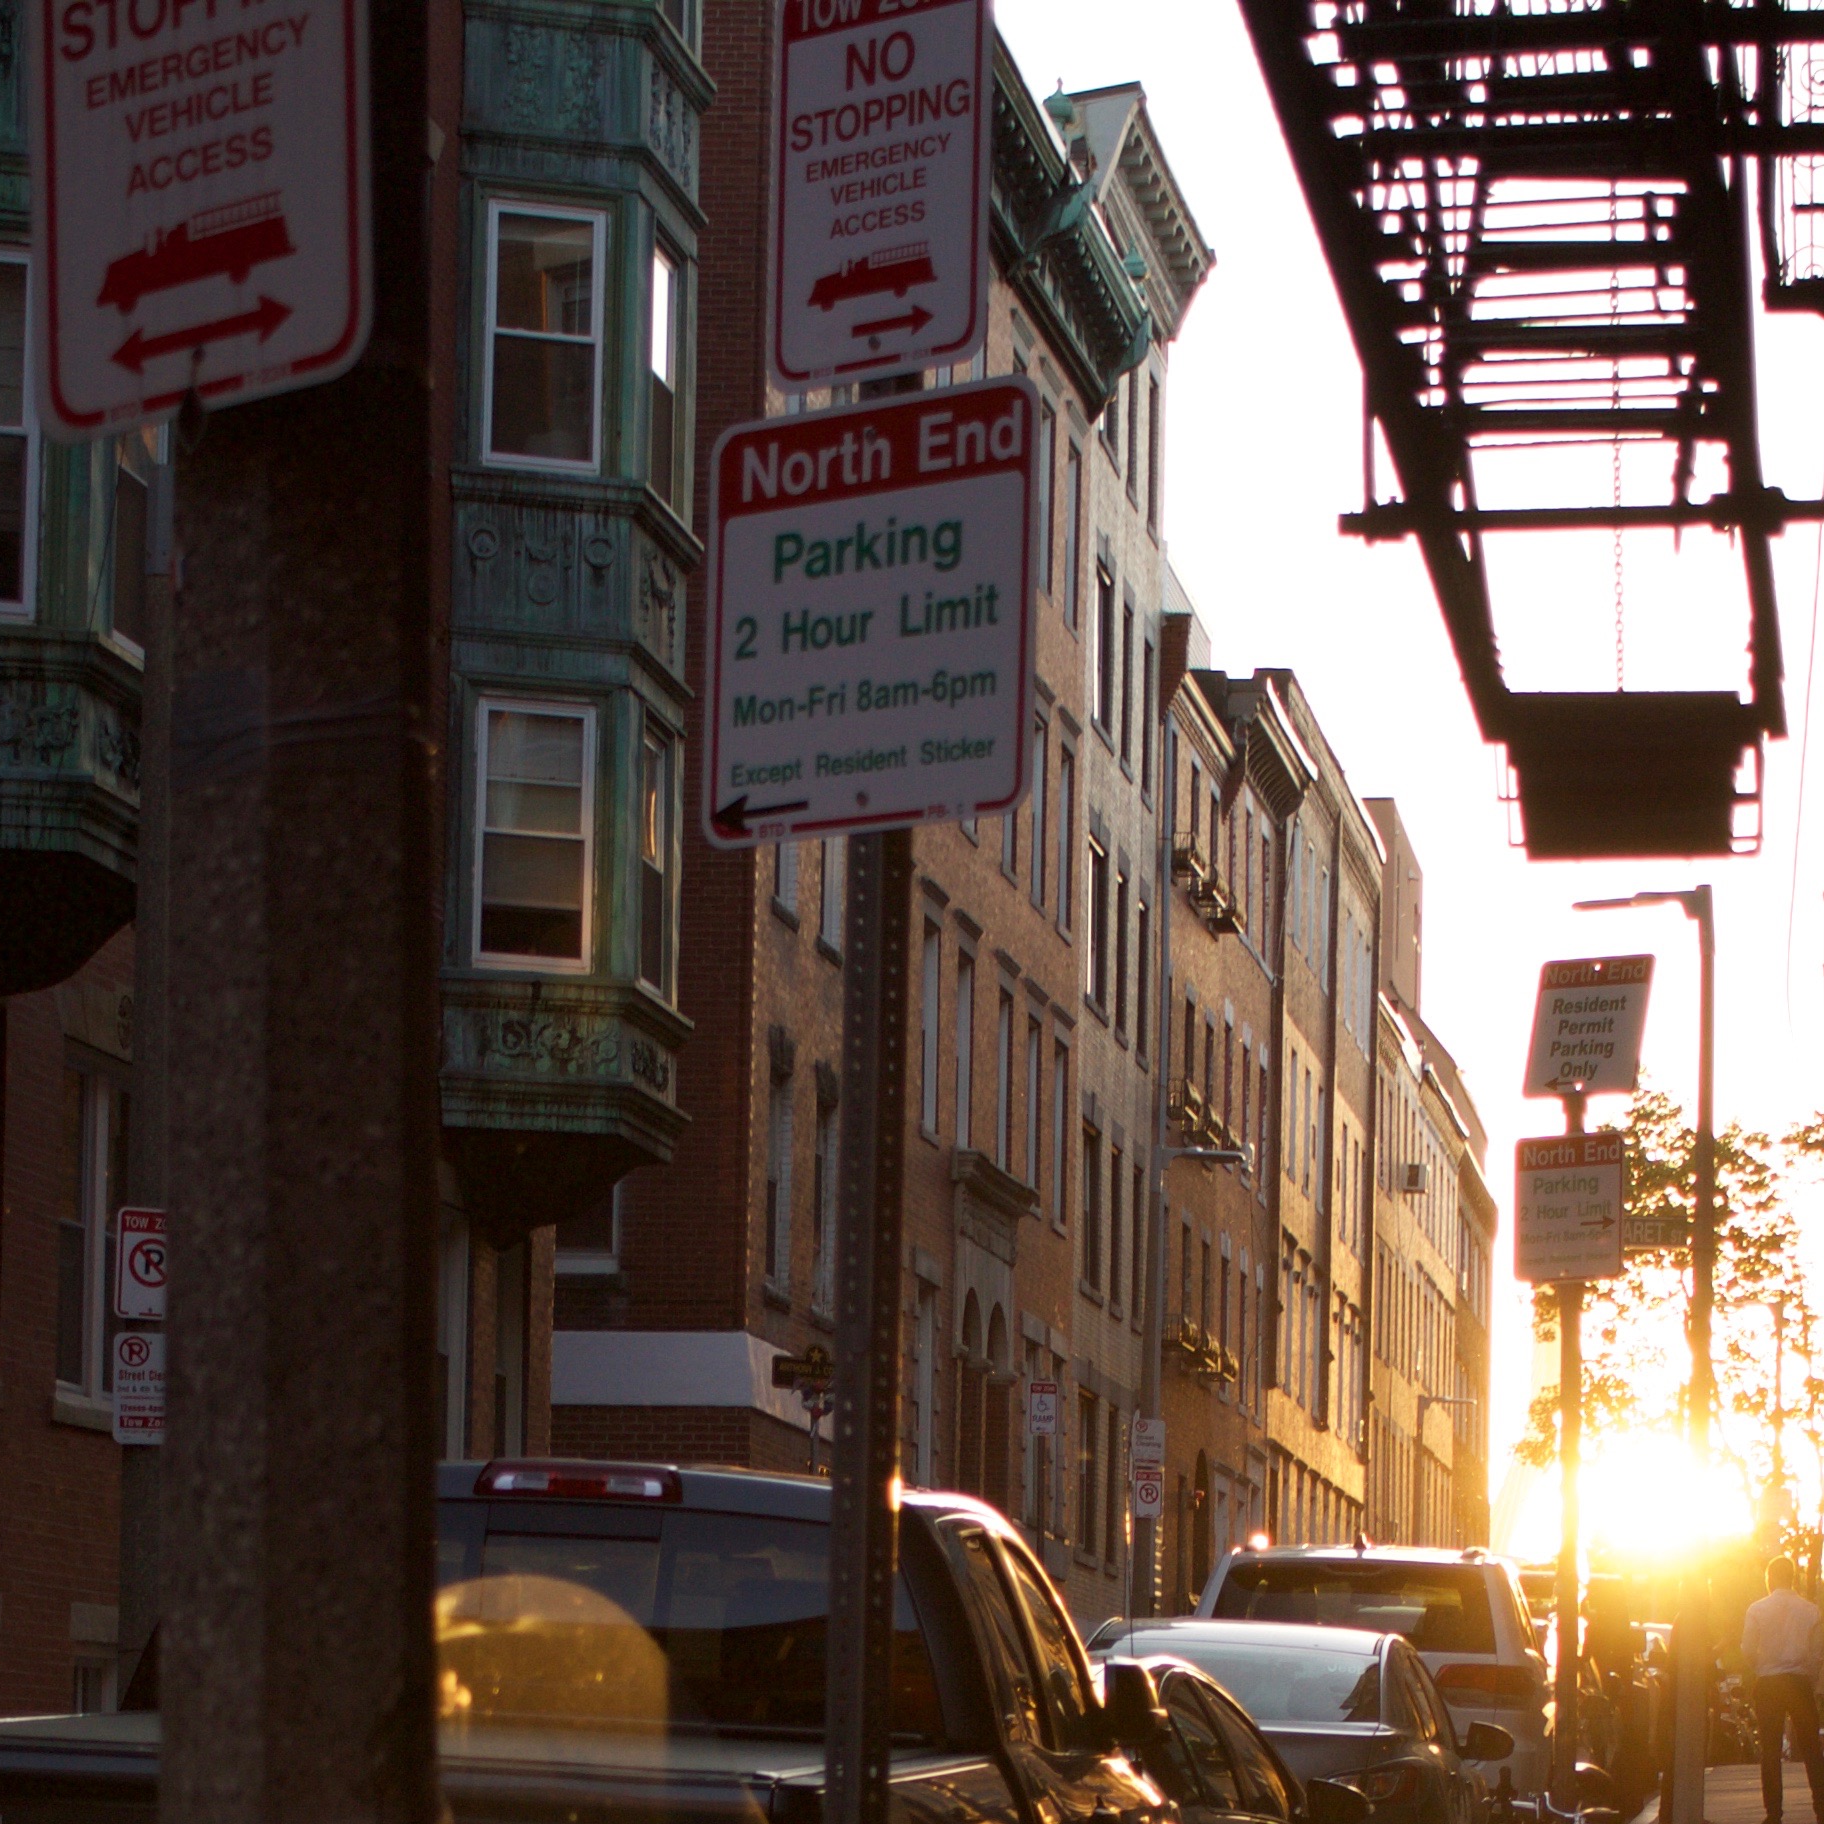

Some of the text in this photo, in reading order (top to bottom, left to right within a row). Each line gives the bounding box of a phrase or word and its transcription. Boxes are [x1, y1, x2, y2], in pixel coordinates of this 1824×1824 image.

[85, 12, 309, 110] EMERGENCY
[845, 30, 916, 92] NO
[125, 72, 274, 143] VEHICLE
[790, 78, 971, 152] STOPPING
[126, 125, 274, 197] ACCESS
[805, 132, 952, 184] EMERGENCY
[830, 167, 927, 206] VEHICLE
[830, 200, 926, 240] ACCESS
[741, 398, 1024, 505] North End
[774, 517, 963, 585] Parking
[733, 582, 999, 661] 2 Hour Limit
[732, 669, 998, 729] Mon-Fri 8am-6pm
[730, 737, 997, 789] Except Resident Sticker
[1547, 959, 1647, 986] North End
[1552, 995, 1628, 1015] Resident
[1558, 1017, 1615, 1036] Permit
[1549, 1039, 1615, 1059] Parking
[1560, 1060, 1598, 1081] Only
[1523, 1139, 1621, 1167] North End
[1533, 1176, 1599, 1196] Parking
[125, 1215, 149, 1229] TOW
[1520, 1199, 1612, 1221] 2 Hour Limit
